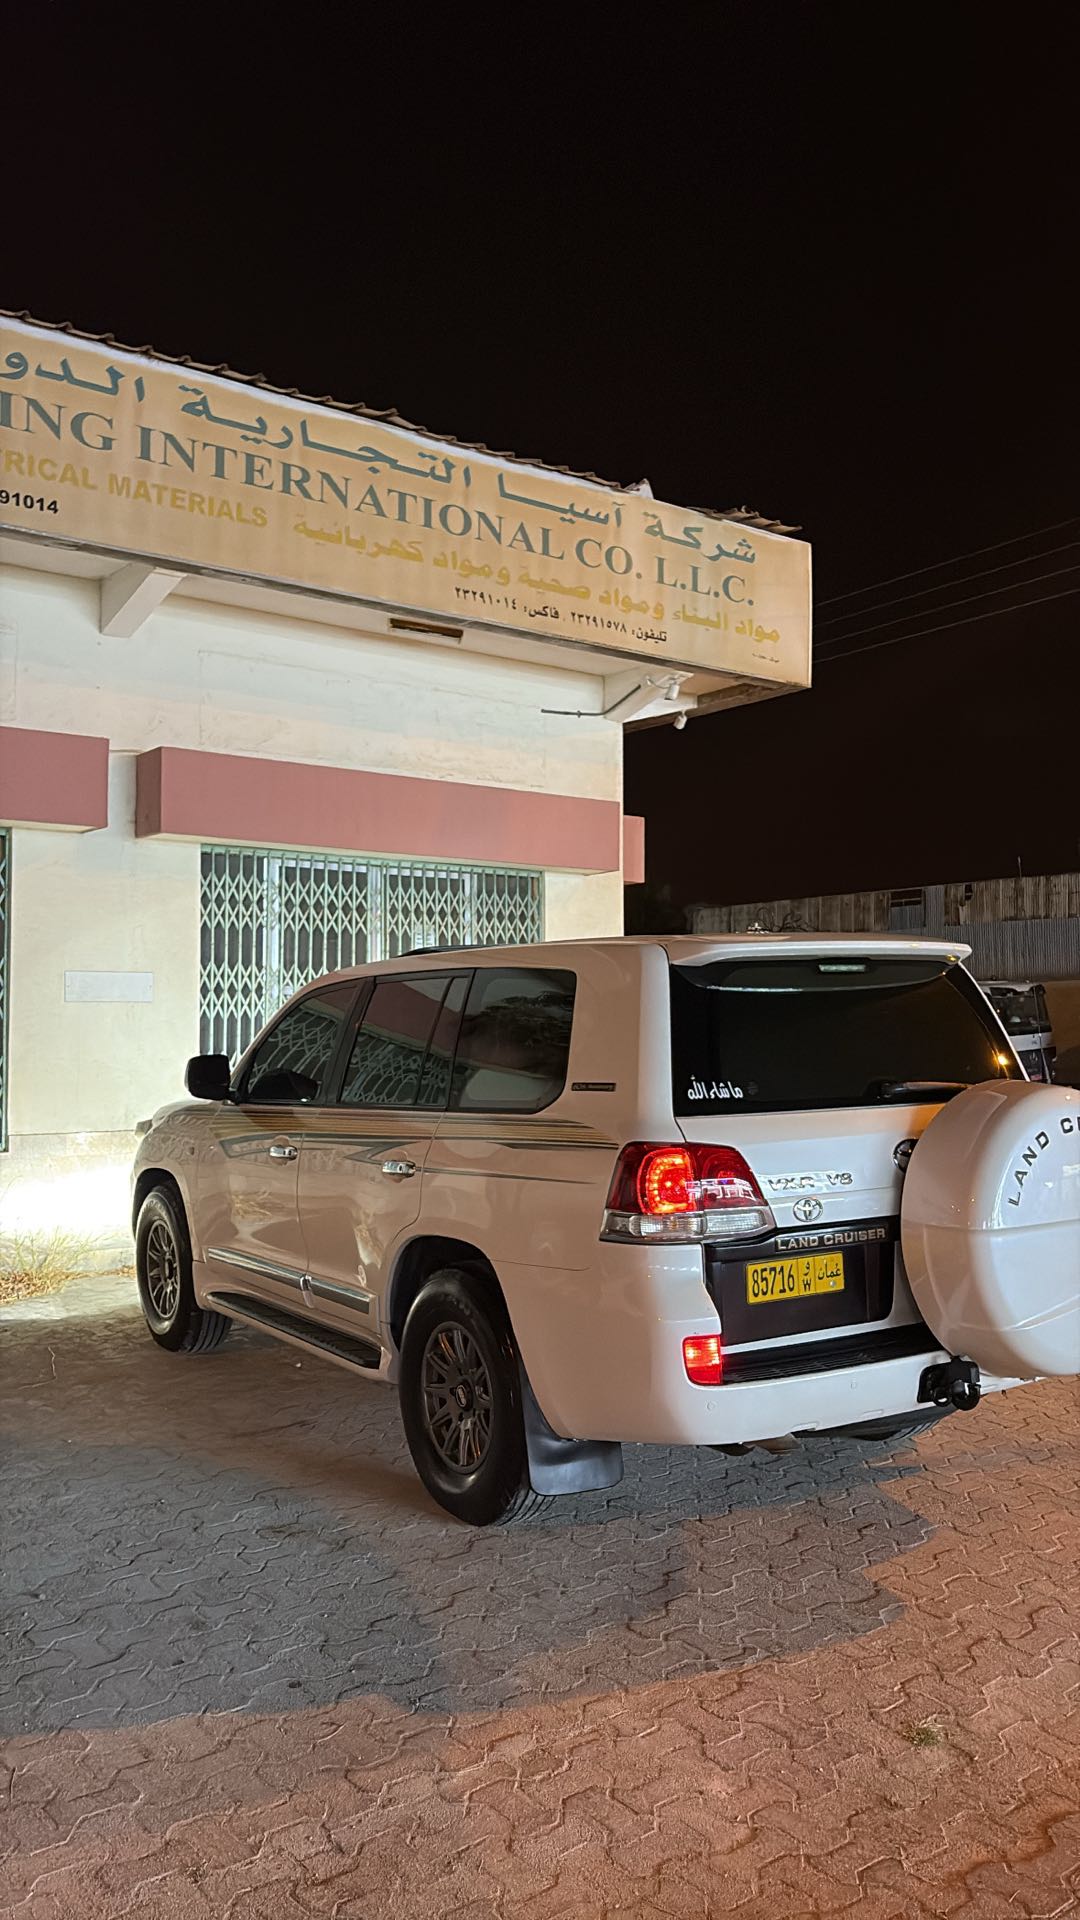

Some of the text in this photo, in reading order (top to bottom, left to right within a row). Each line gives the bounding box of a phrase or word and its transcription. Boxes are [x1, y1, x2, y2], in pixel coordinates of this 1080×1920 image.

[178, 384, 471, 488] التجارية
[0, 448, 268, 528] RICAL MATERIALS
[0, 390, 754, 606] ING INTERNATIONAL CO. L.L.C.
[0, 489, 59, 515] 91014
[642, 510, 756, 564] شركة
[518, 566, 591, 601] صحية
[671, 603, 730, 632] البناء
[735, 618, 781, 644] مواد
[687, 1074, 709, 1100] الله
[768, 1172, 853, 1191] VXR V8
[1007, 1131, 1050, 1206] LAND
[776, 1228, 887, 1250] LAND CRUISER
[751, 1263, 795, 1298] 85716
[802, 1277, 812, 1292] W
